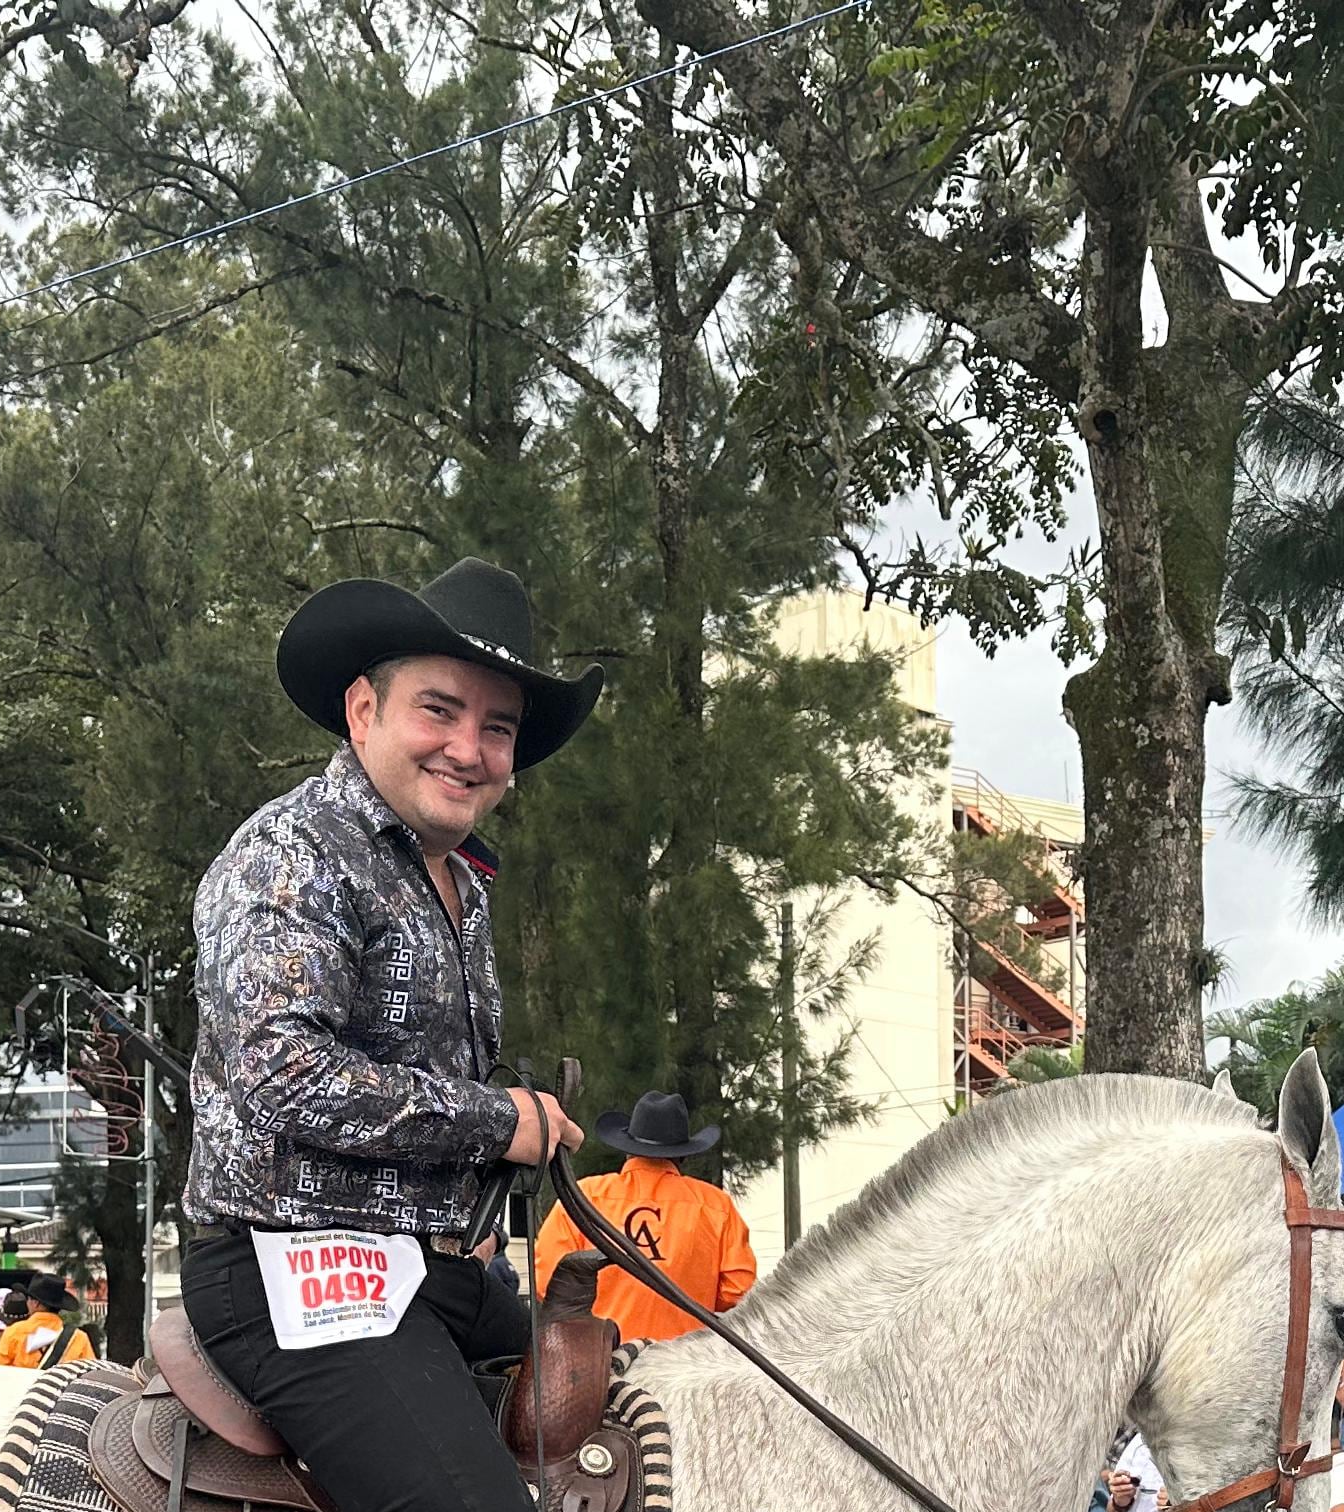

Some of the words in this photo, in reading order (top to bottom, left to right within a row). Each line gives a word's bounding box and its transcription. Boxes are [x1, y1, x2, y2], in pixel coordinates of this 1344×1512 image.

[285, 1249, 315, 1274] YO
[320, 1246, 389, 1272] APOYO
[301, 1272, 388, 1309] 0492
